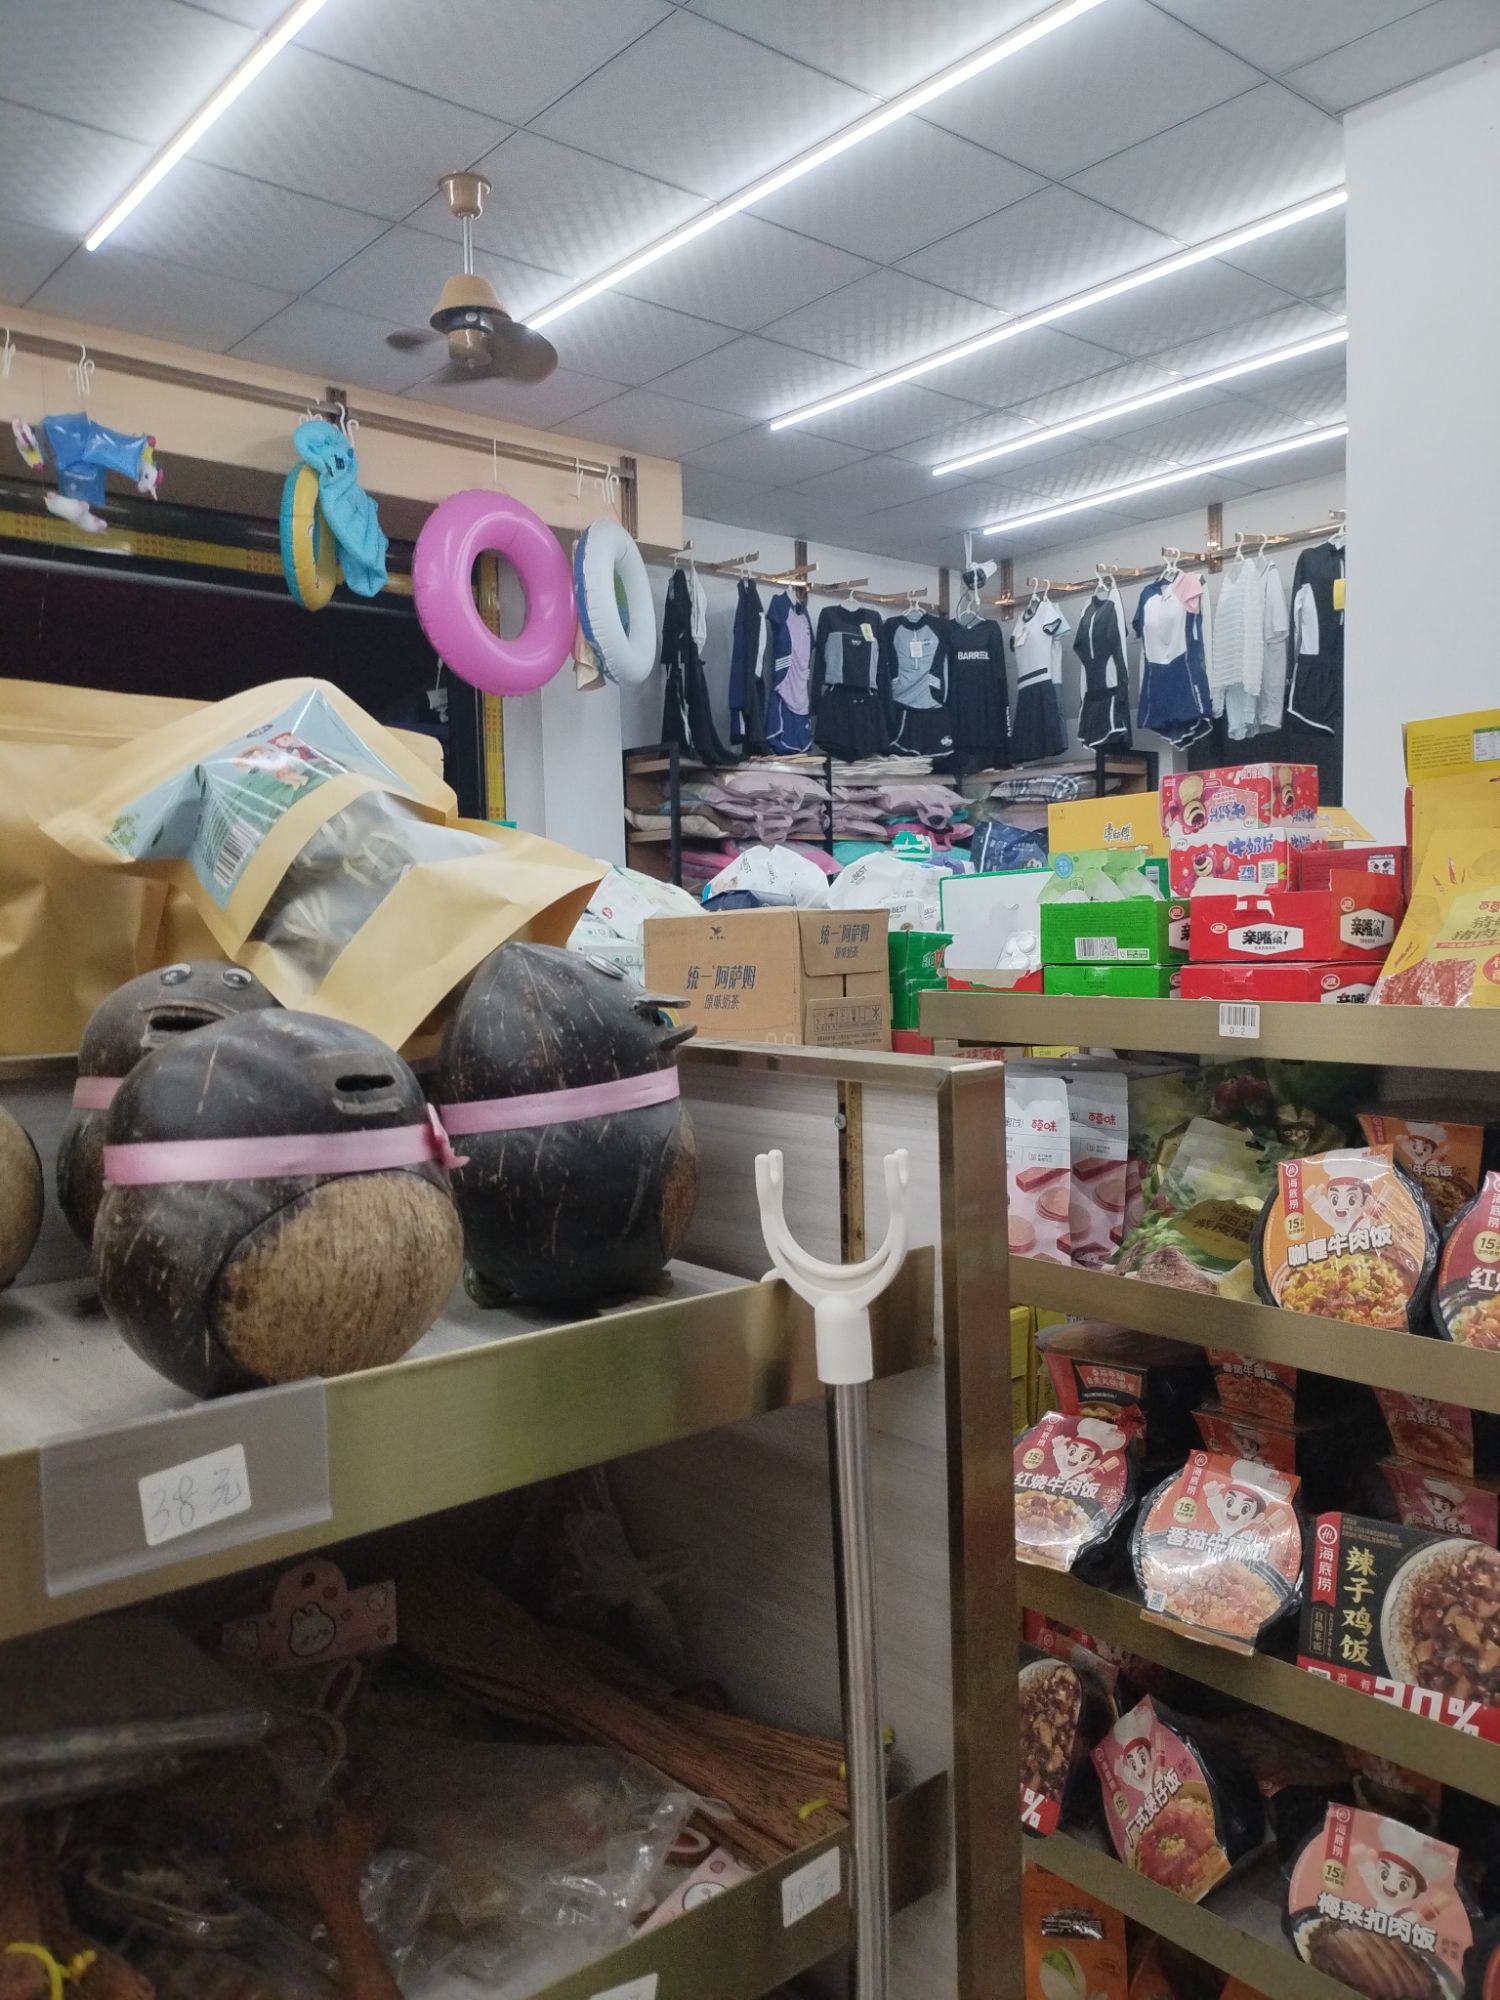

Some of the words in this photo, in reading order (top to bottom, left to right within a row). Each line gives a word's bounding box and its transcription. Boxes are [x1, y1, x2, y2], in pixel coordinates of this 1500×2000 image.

[957, 651, 990, 660] BARREL
[1227, 834, 1275, 859] 牛奶片
[685, 965, 757, 991] 统一阿萨姆
[703, 994, 740, 1010] 原味奶茶
[1031, 1119, 1058, 1132] 百草味
[1088, 1112, 1117, 1126] 百草味
[1287, 1178, 1299, 1210] 海底捞
[1287, 1218, 1300, 1229] 15
[1287, 1223, 1393, 1267] 咖喱牛肉饭
[1479, 1237, 1496, 1249] 15
[1468, 1266, 1500, 1292] 红
[1014, 1471, 1101, 1499] 红烧牛肉饭
[1178, 1502, 1191, 1512] 15
[1316, 1546, 1334, 1593] 海底捞
[1339, 1546, 1377, 1667] 辣子鸡饭
[1326, 1864, 1340, 1878] 15
[1317, 1892, 1438, 1953] 梅菜扣肉饭
